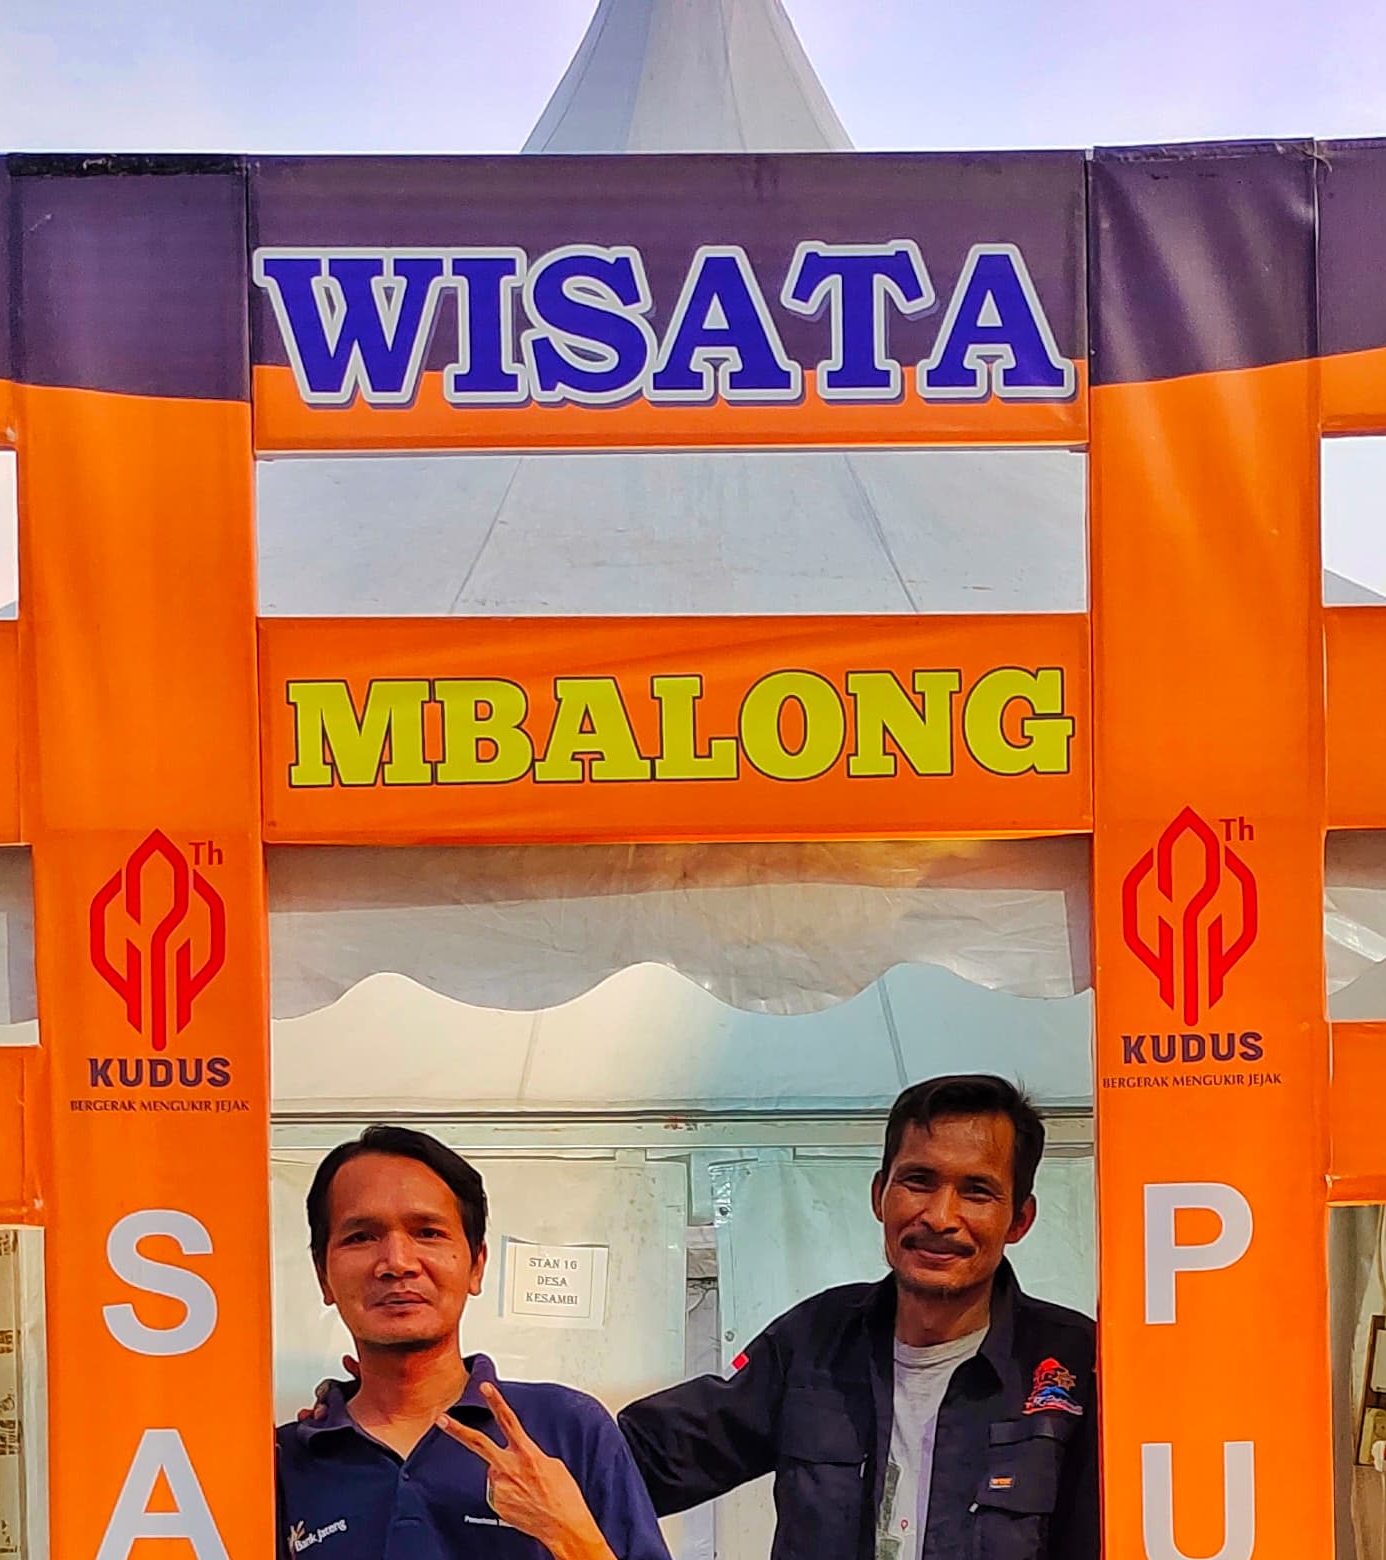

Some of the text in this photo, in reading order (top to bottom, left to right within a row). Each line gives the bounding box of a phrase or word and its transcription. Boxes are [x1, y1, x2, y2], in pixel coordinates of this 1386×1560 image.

[255, 241, 1076, 405] WISATA
[288, 668, 1074, 787] MBALONG
[1219, 816, 1254, 842] Th
[189, 840, 224, 866] Th
[1121, 1031, 1264, 1065] KUDUS
[88, 1056, 232, 1088] KUDUS
[1102, 1072, 1283, 1089] BERGERAK MENGUKIR JEJAK
[70, 1099, 251, 1113] BERGERAK MENGUKIR JEJAK
[528, 1257, 560, 1269] STAN
[537, 1275, 568, 1287] DESA
[526, 1291, 578, 1305] KESAMBI
